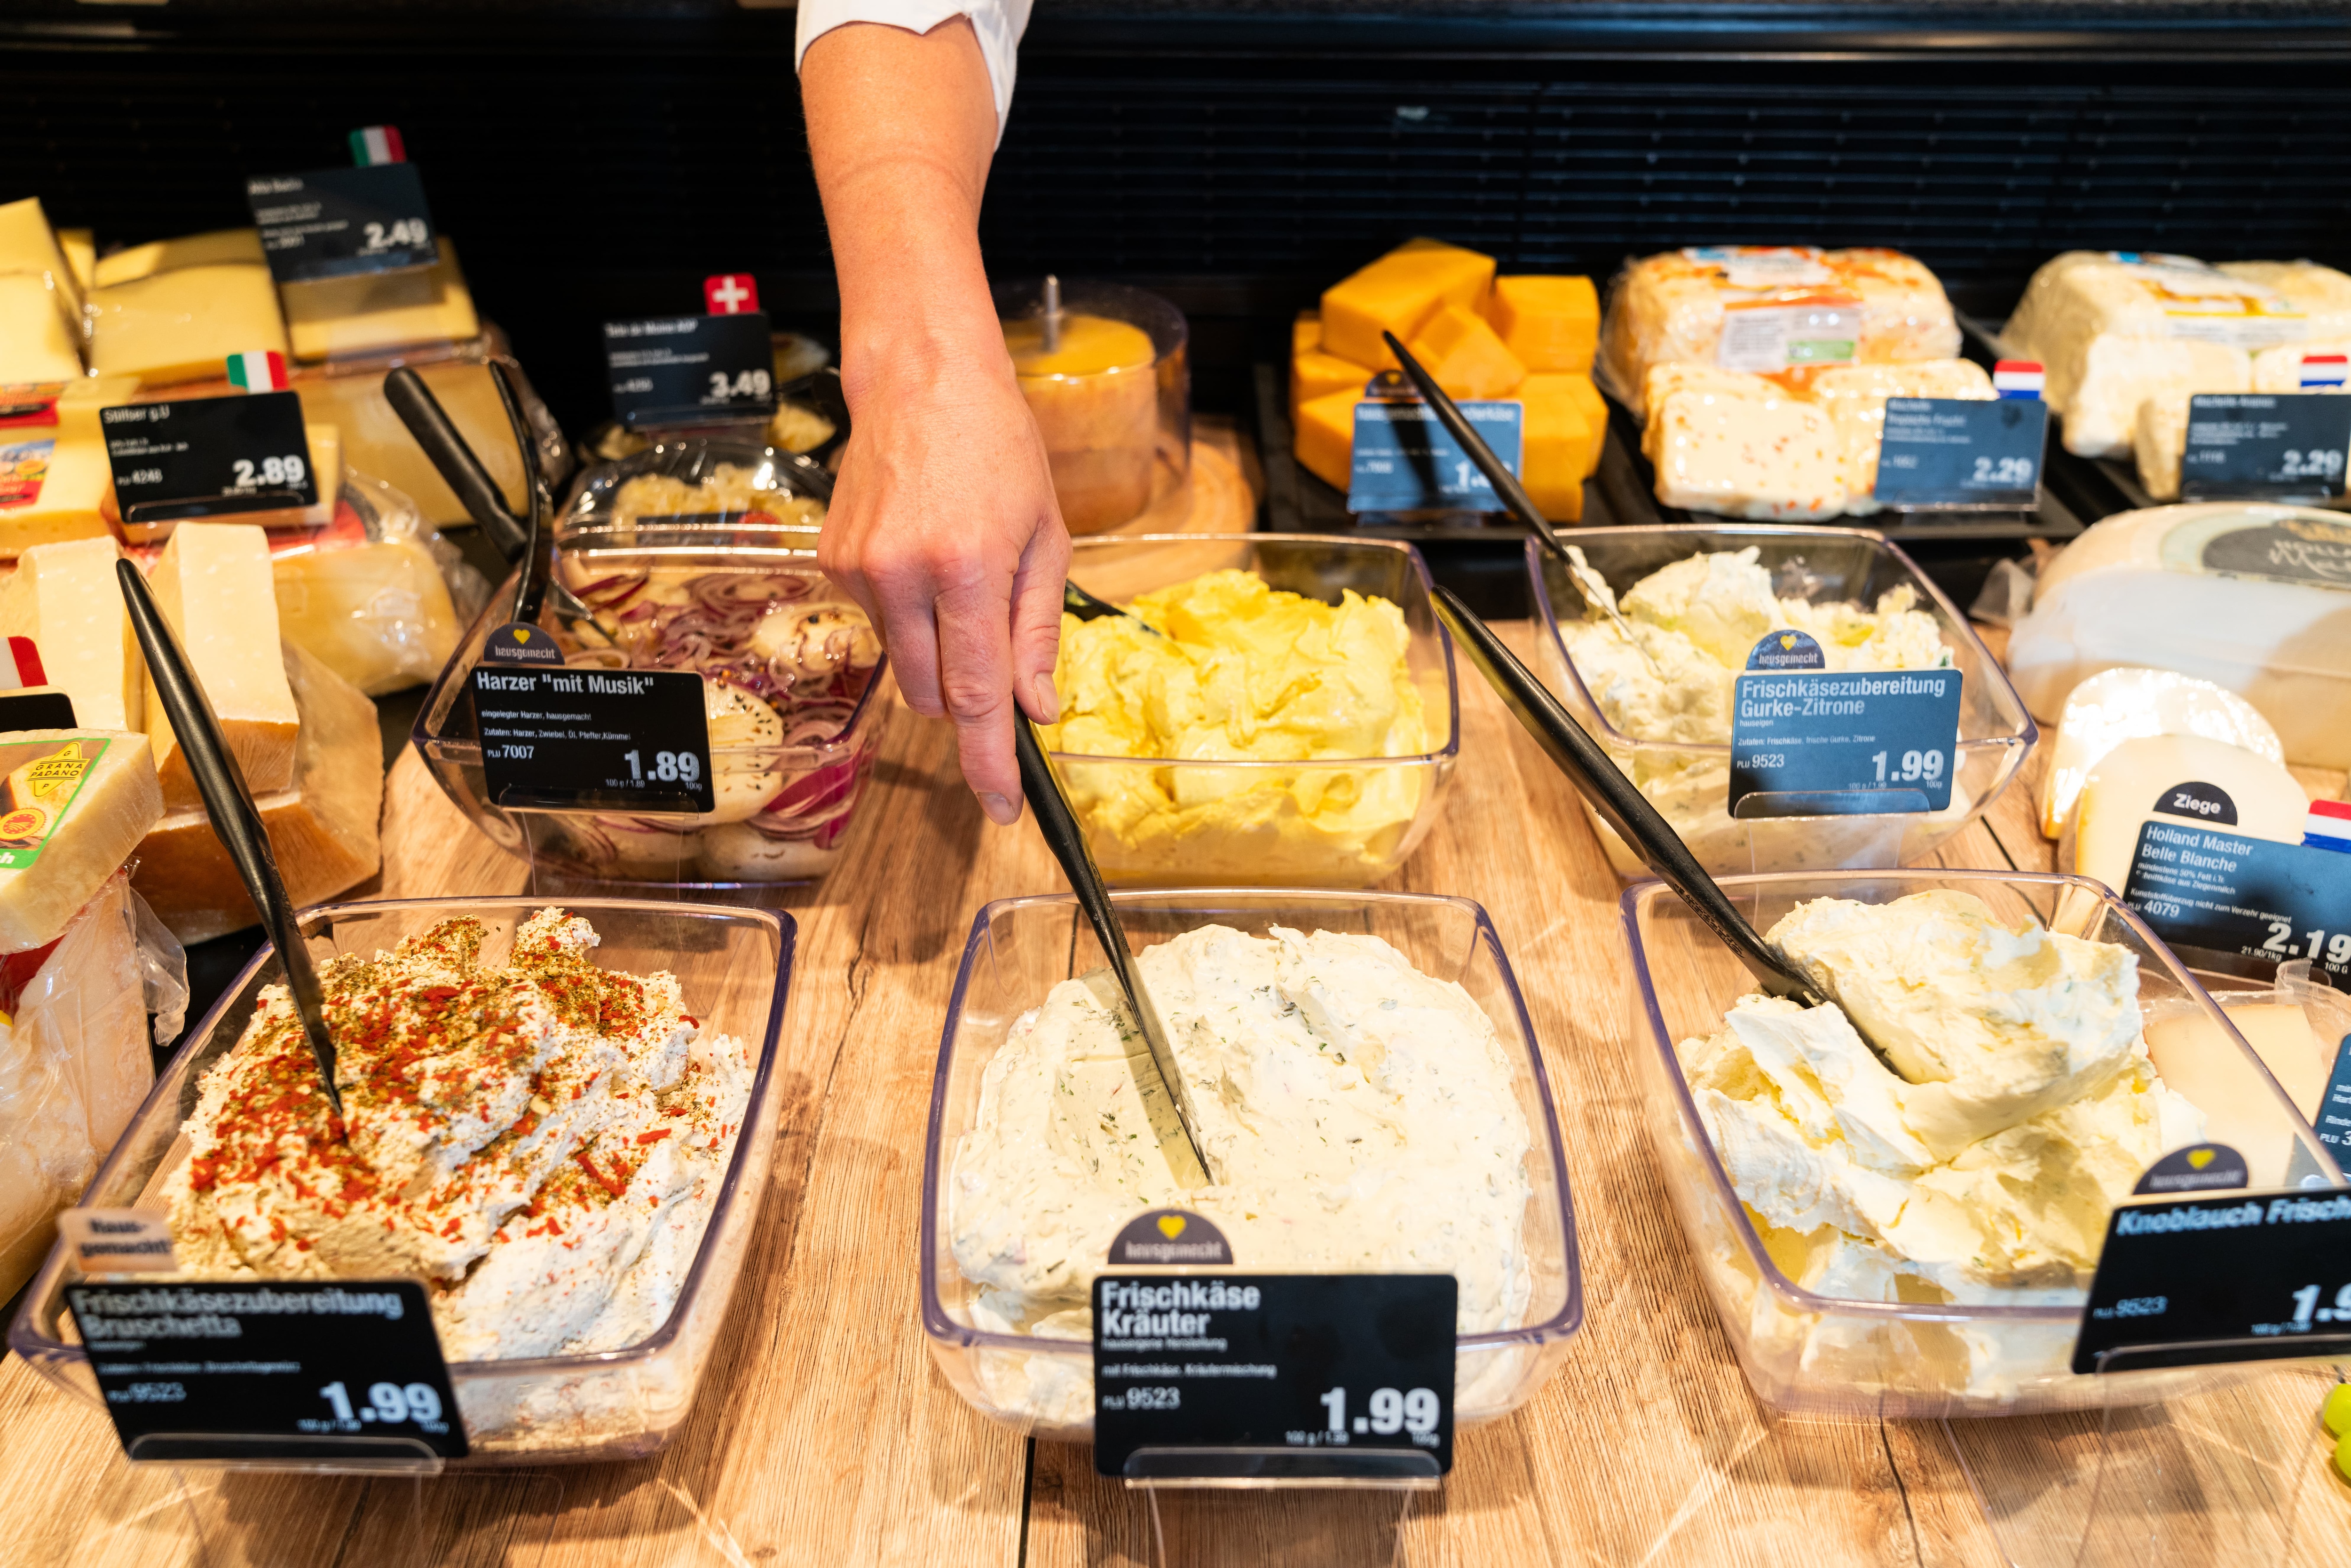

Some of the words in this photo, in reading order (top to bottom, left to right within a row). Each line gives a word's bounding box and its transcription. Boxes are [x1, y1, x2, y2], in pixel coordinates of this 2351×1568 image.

[363, 217, 429, 251] 2.49
[709, 369, 772, 397] 3.49
[233, 454, 305, 487] 2.89
[1972, 456, 2033, 483] 2.29
[2282, 449, 2343, 476] 2.29
[495, 645, 556, 660] hausgemacht
[1759, 653, 1818, 667] hausgemacht
[477, 671, 536, 691] Harzer
[542, 673, 584, 693] "mit
[588, 675, 654, 695] Musik"
[1742, 676, 1946, 698] Frischkäsezubereitung
[481, 709, 519, 720] eingelegter
[521, 710, 545, 720] Harzer,
[546, 711, 592, 722] hausgemacht
[1741, 698, 1865, 718] Gurke-Zitrone
[1740, 719, 1774, 728] hauseigen
[488, 749, 501, 759] PLU
[501, 744, 535, 759] 7007
[1736, 760, 1750, 769] PLU
[1752, 753, 1785, 769] 9523
[624, 749, 700, 782] 1.89
[1872, 749, 1944, 782] 1.99
[2173, 793, 2221, 815] Ziege
[2146, 825, 2201, 847] Holland
[2202, 835, 2254, 857] Master
[2141, 843, 2177, 862] Belle
[2179, 850, 2237, 873] Blanche
[2144, 899, 2180, 918] 4079
[2262, 922, 2351, 964] 2.19
[2325, 961, 2340, 973] 100
[2319, 1133, 2340, 1144] PLU
[2116, 1201, 2263, 1236] Knoblauch
[71, 1288, 404, 1320] Frischkäsezubereitung
[1101, 1280, 1261, 1311] Frischkäse
[81, 1313, 243, 1339] Bruschetta
[1101, 1308, 1212, 1338] Kräuter
[129, 1382, 187, 1402] 9523
[319, 1381, 443, 1424] 1.99
[1126, 1387, 1181, 1410] 9523
[1320, 1387, 1440, 1435] 1.99
